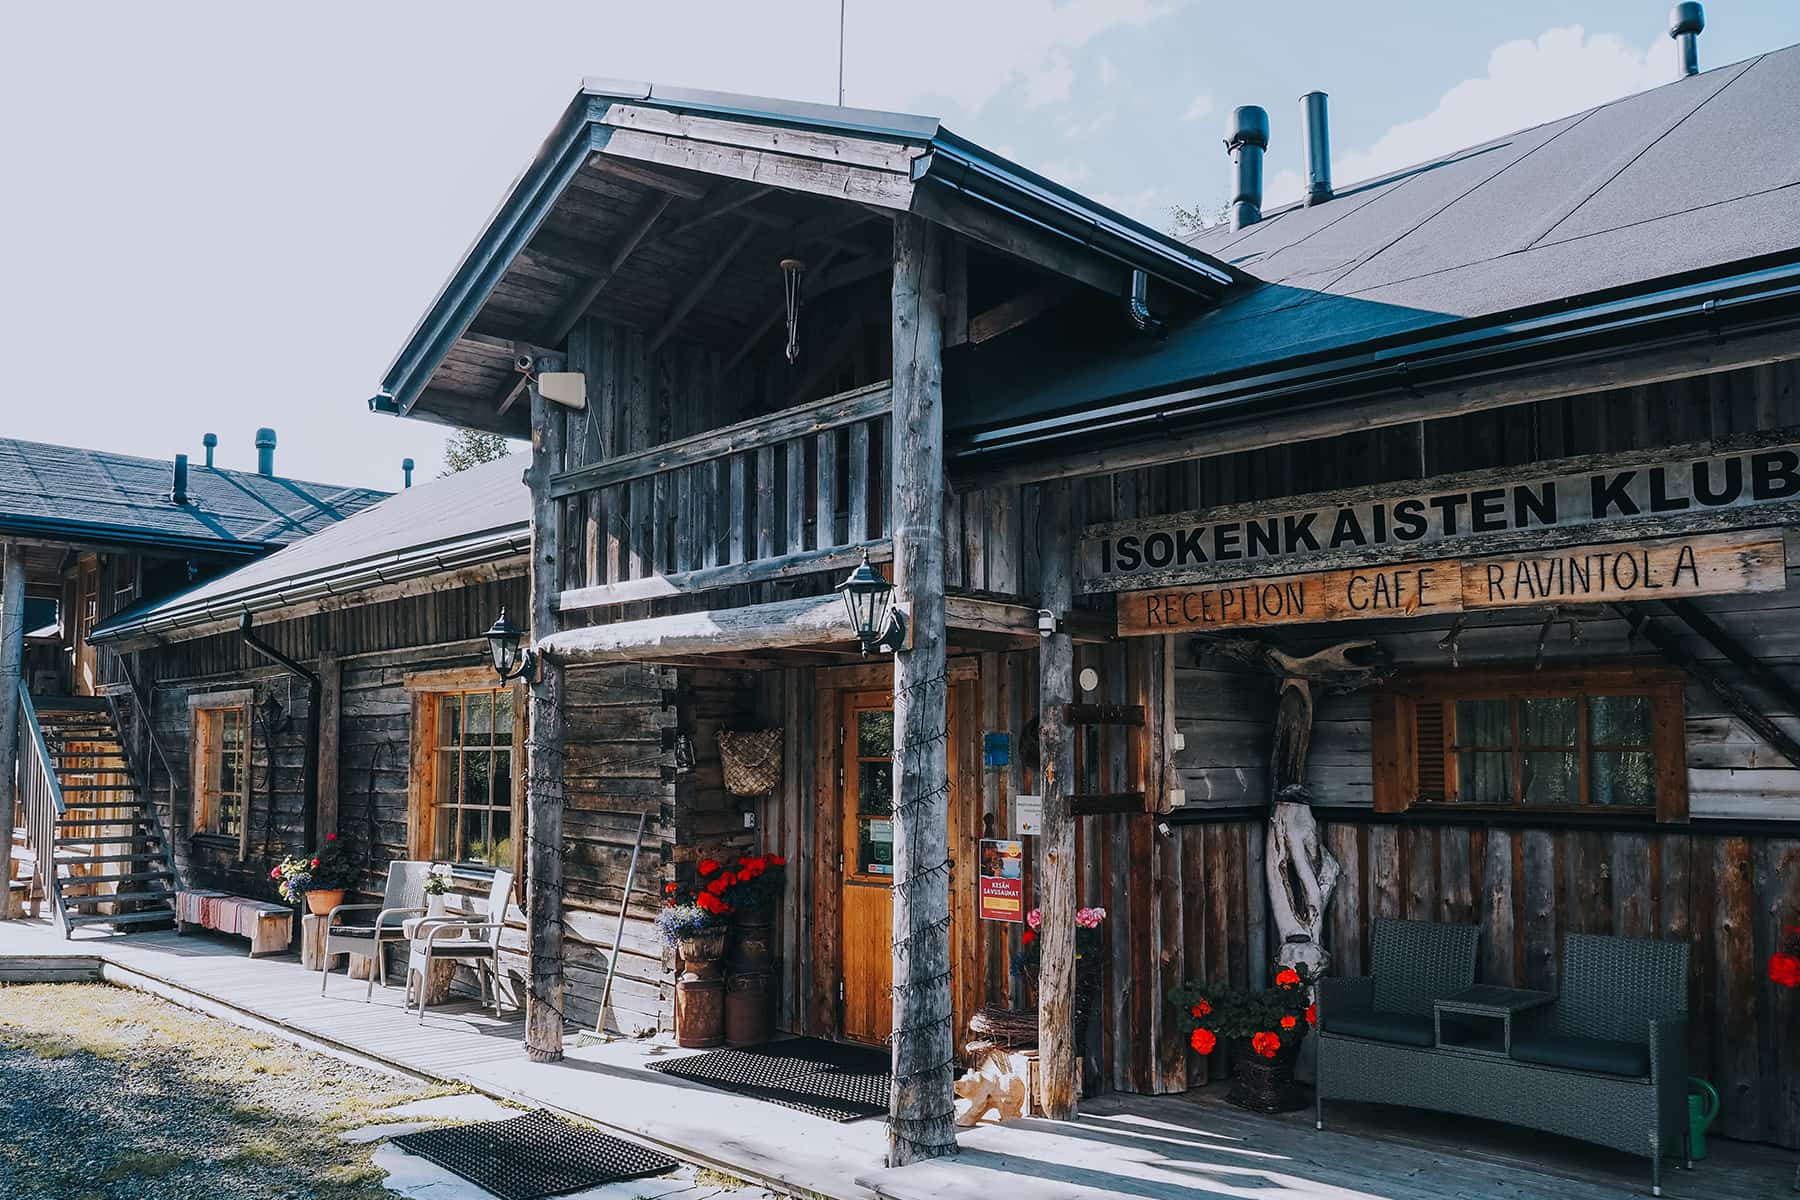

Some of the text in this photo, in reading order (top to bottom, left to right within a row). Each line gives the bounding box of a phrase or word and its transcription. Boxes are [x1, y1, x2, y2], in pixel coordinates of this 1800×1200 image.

[1102, 450, 1800, 573] ISOKENKÄISTEN KLUB
[1146, 545, 1700, 626] RECEPTION CAFE RAVINTOLA
